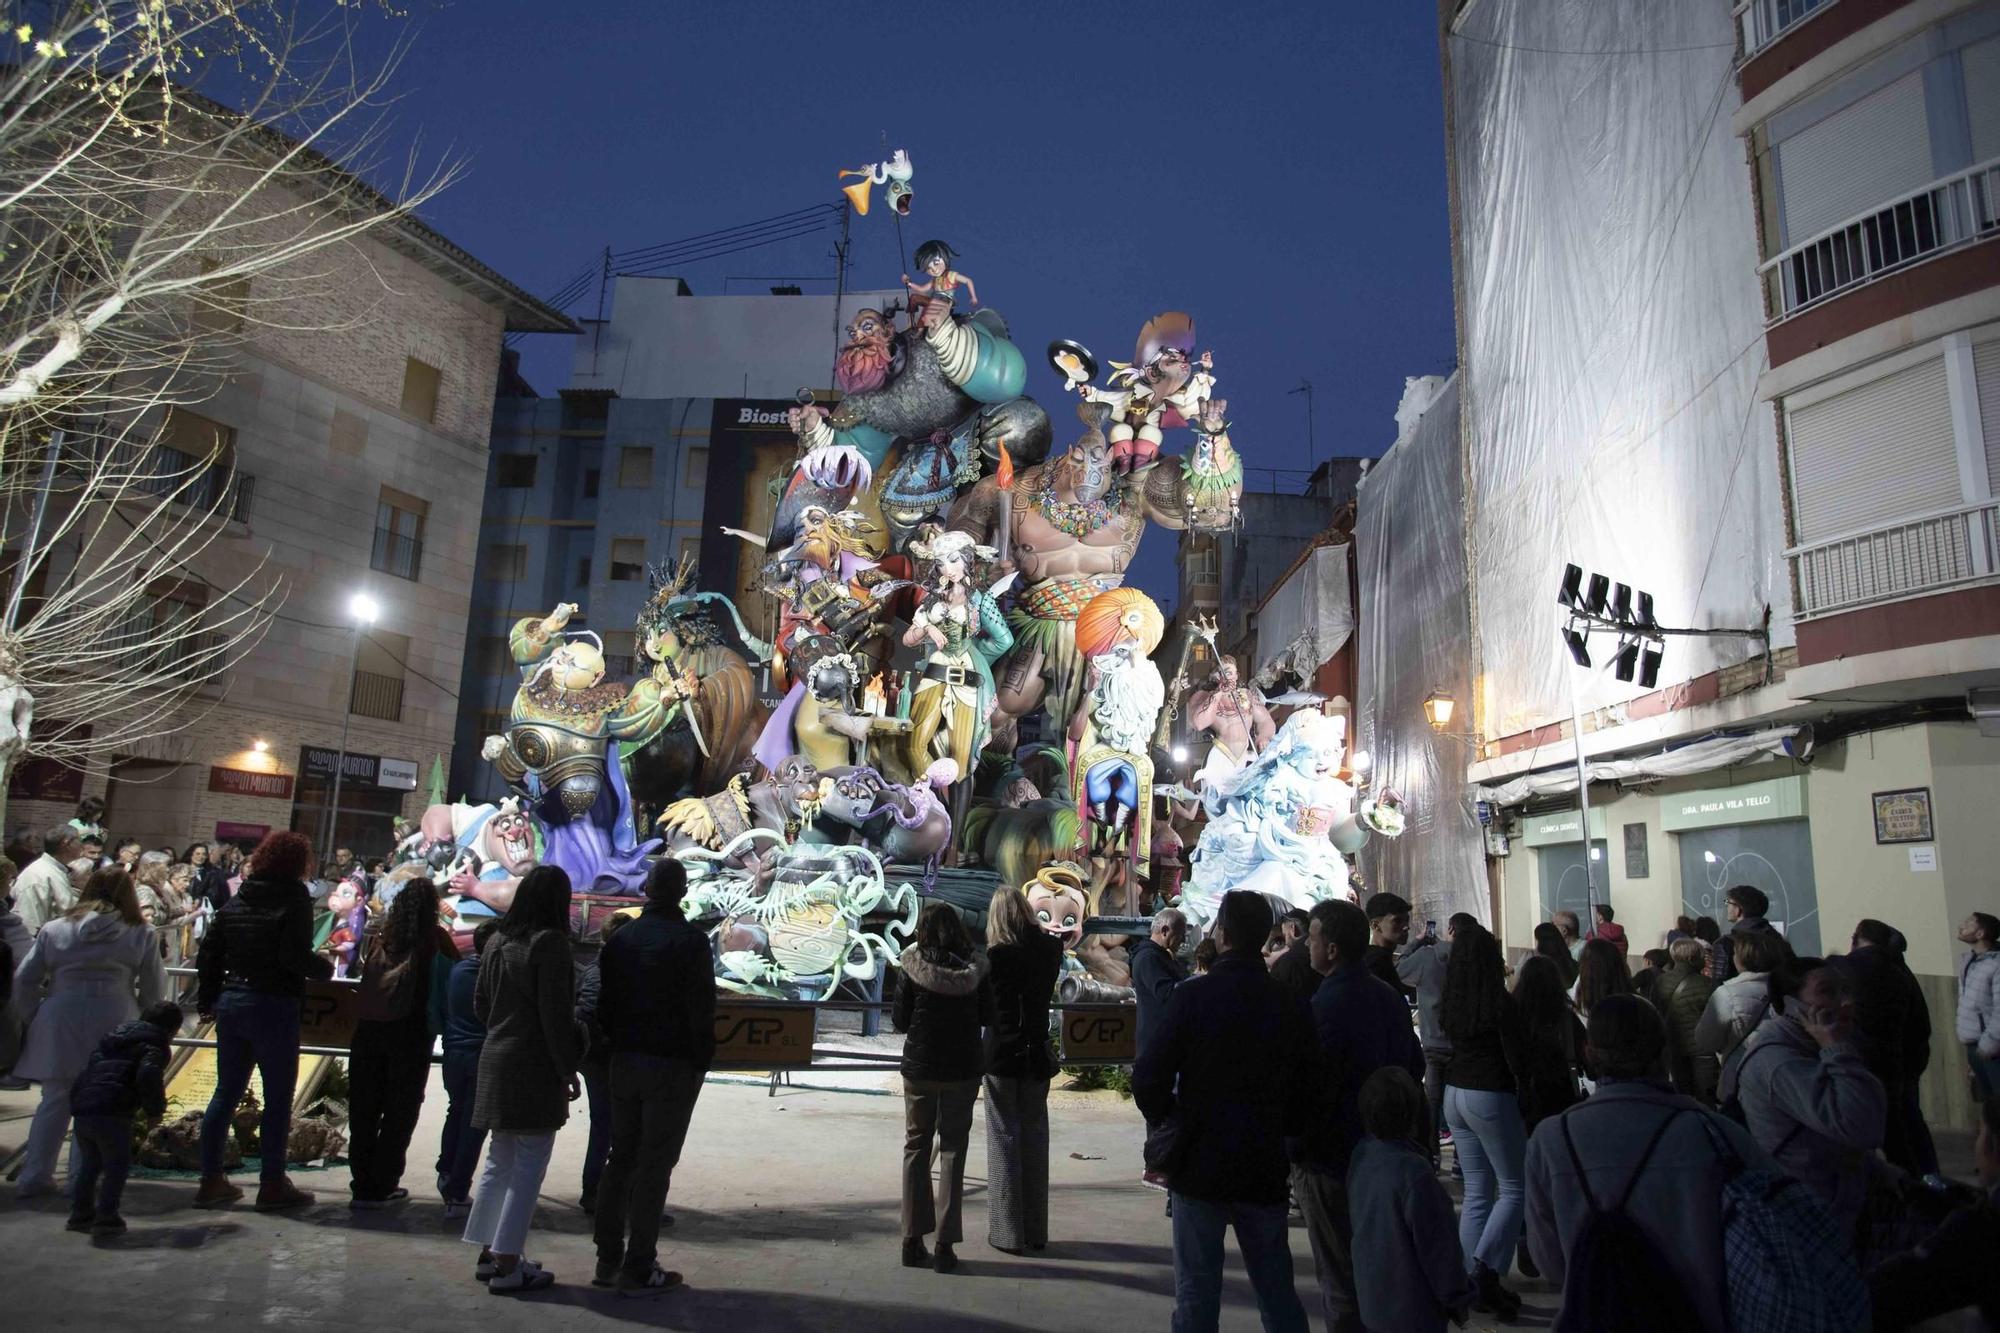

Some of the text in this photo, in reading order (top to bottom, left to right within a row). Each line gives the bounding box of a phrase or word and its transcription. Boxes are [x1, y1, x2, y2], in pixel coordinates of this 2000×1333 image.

[1682, 795, 1770, 815] DRA. PAULA VILA TELLO
